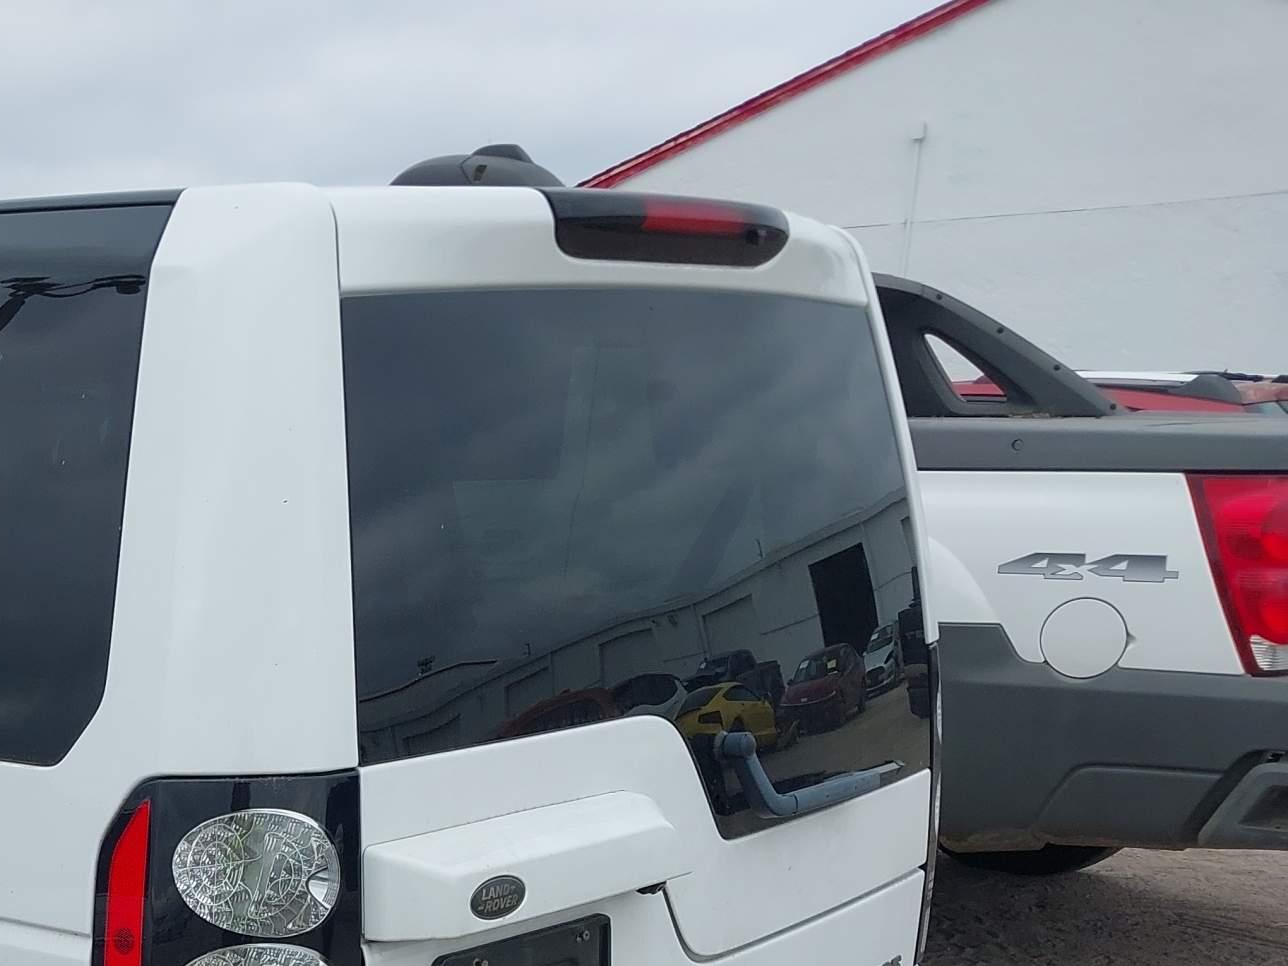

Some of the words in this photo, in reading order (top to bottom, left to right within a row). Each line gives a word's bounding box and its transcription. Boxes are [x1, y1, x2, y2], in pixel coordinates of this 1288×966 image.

[998, 552, 1179, 584] 4x4
[481, 883, 512, 901] LAND
[482, 894, 520, 913] ROVER
